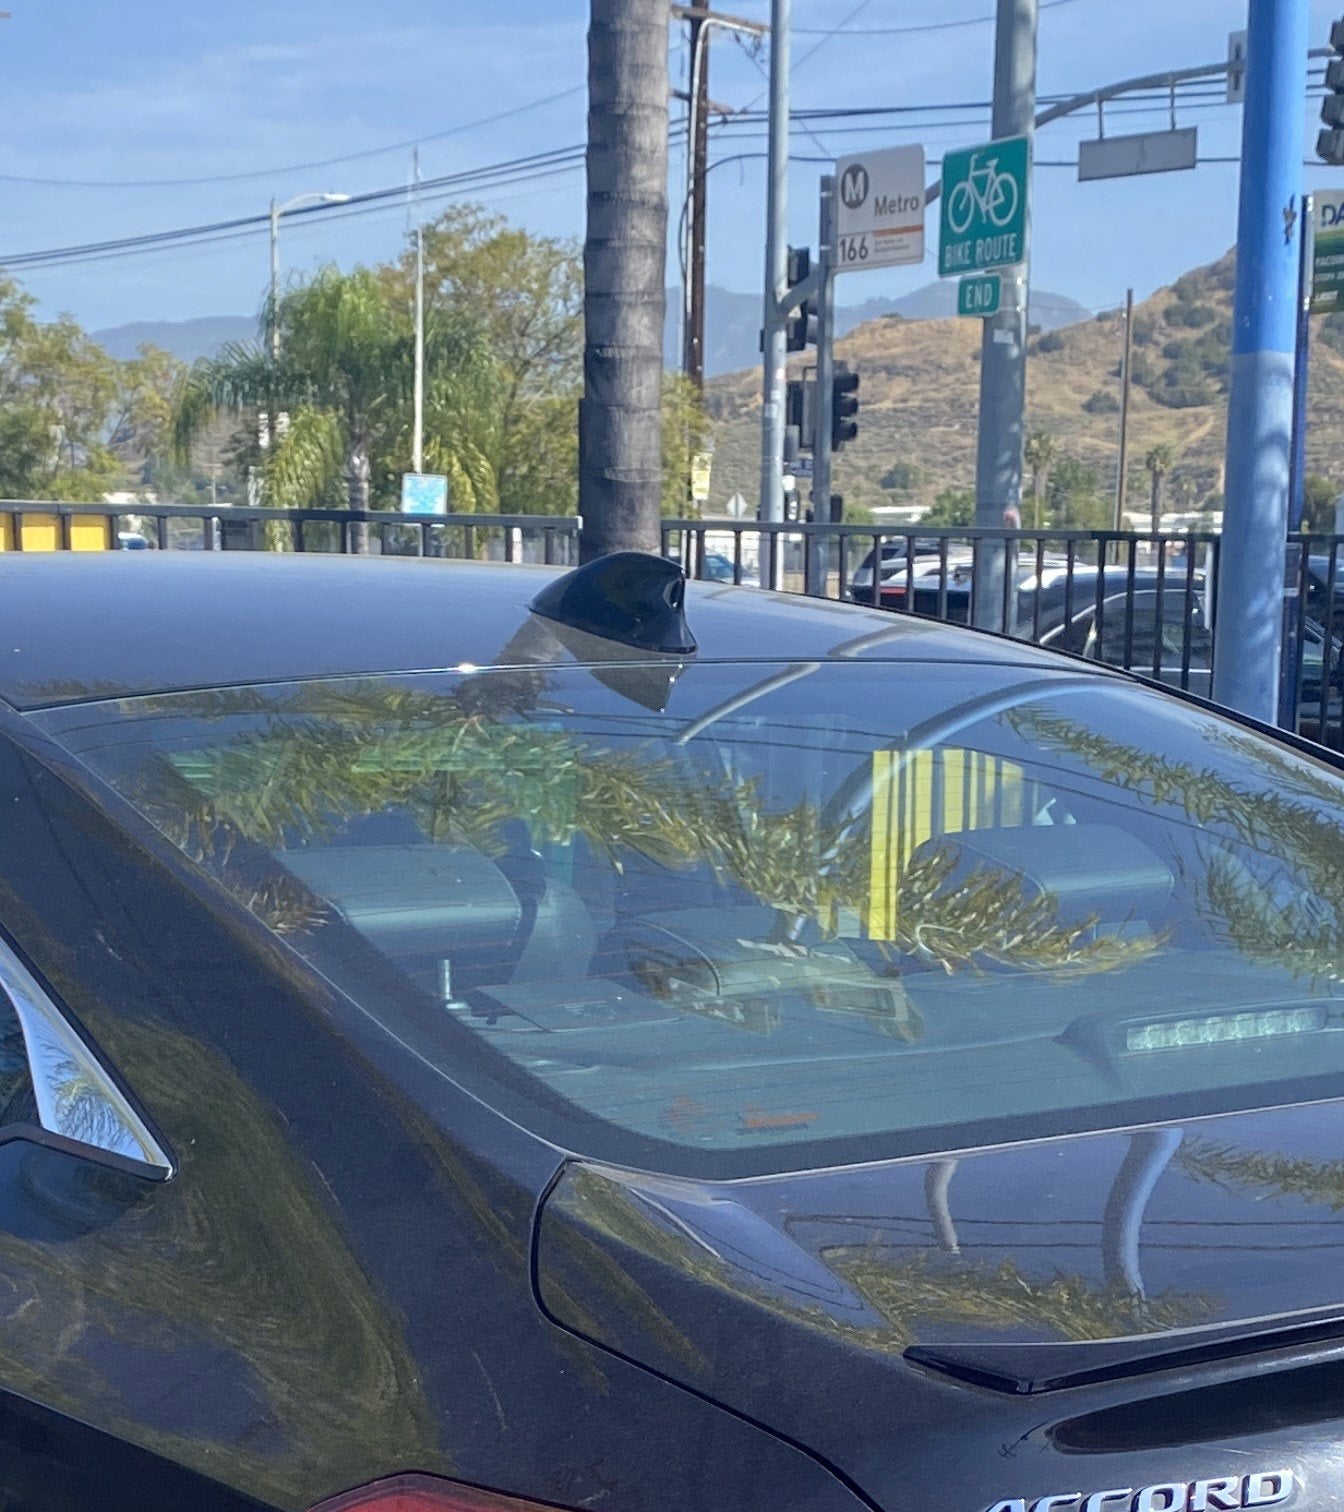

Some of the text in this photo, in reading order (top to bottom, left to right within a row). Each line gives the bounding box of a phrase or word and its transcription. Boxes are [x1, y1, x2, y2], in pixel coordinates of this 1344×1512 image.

[874, 194, 919, 216] Metro
[840, 236, 869, 262] 166
[945, 241, 972, 268] BIKE
[976, 233, 1017, 266] ROUTE
[965, 283, 993, 309] END
